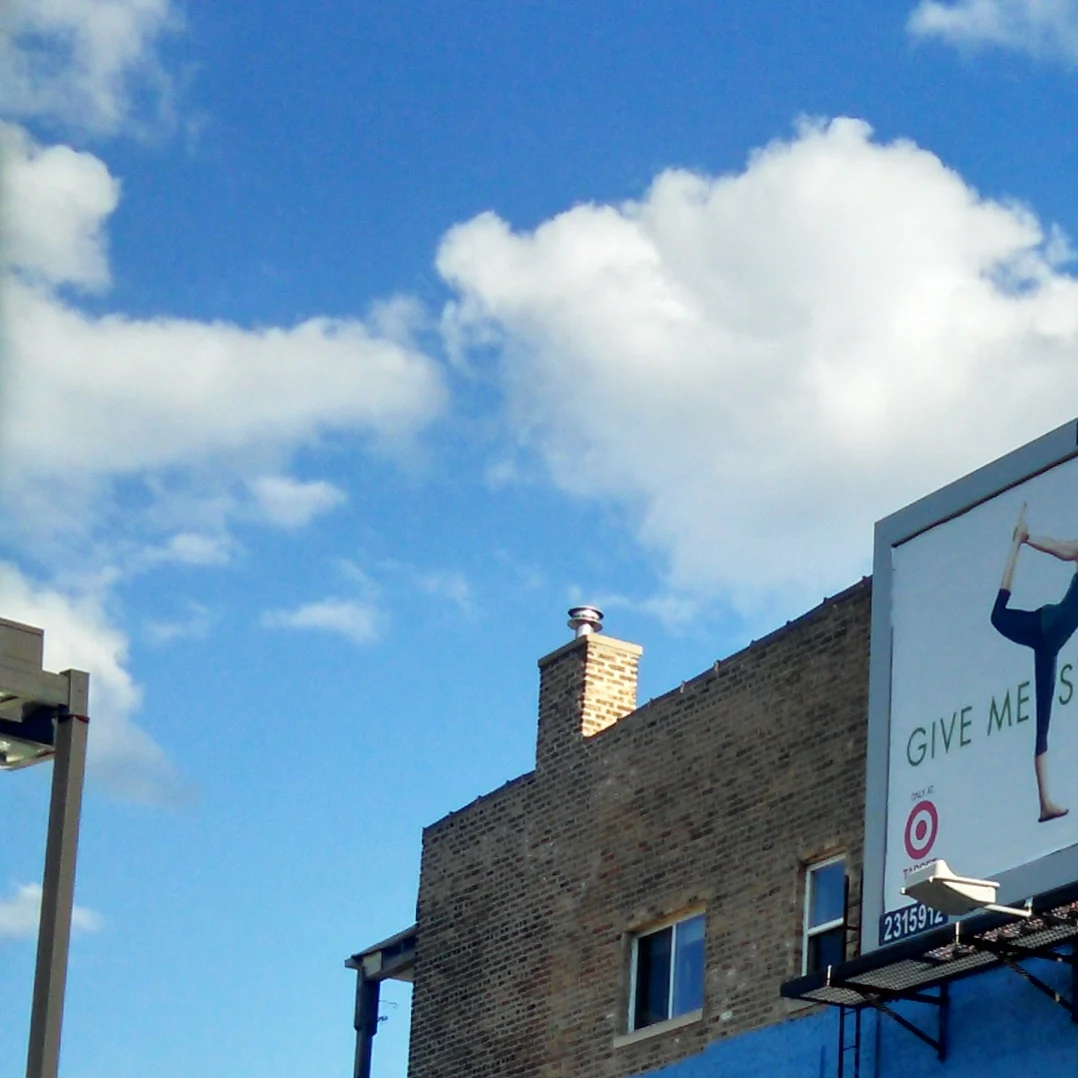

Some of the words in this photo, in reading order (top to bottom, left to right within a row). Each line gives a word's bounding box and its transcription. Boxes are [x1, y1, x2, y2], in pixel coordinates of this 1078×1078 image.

[906, 706, 973, 767] GIVE
[987, 681, 1031, 736] ME
[883, 903, 943, 941] 2315912
